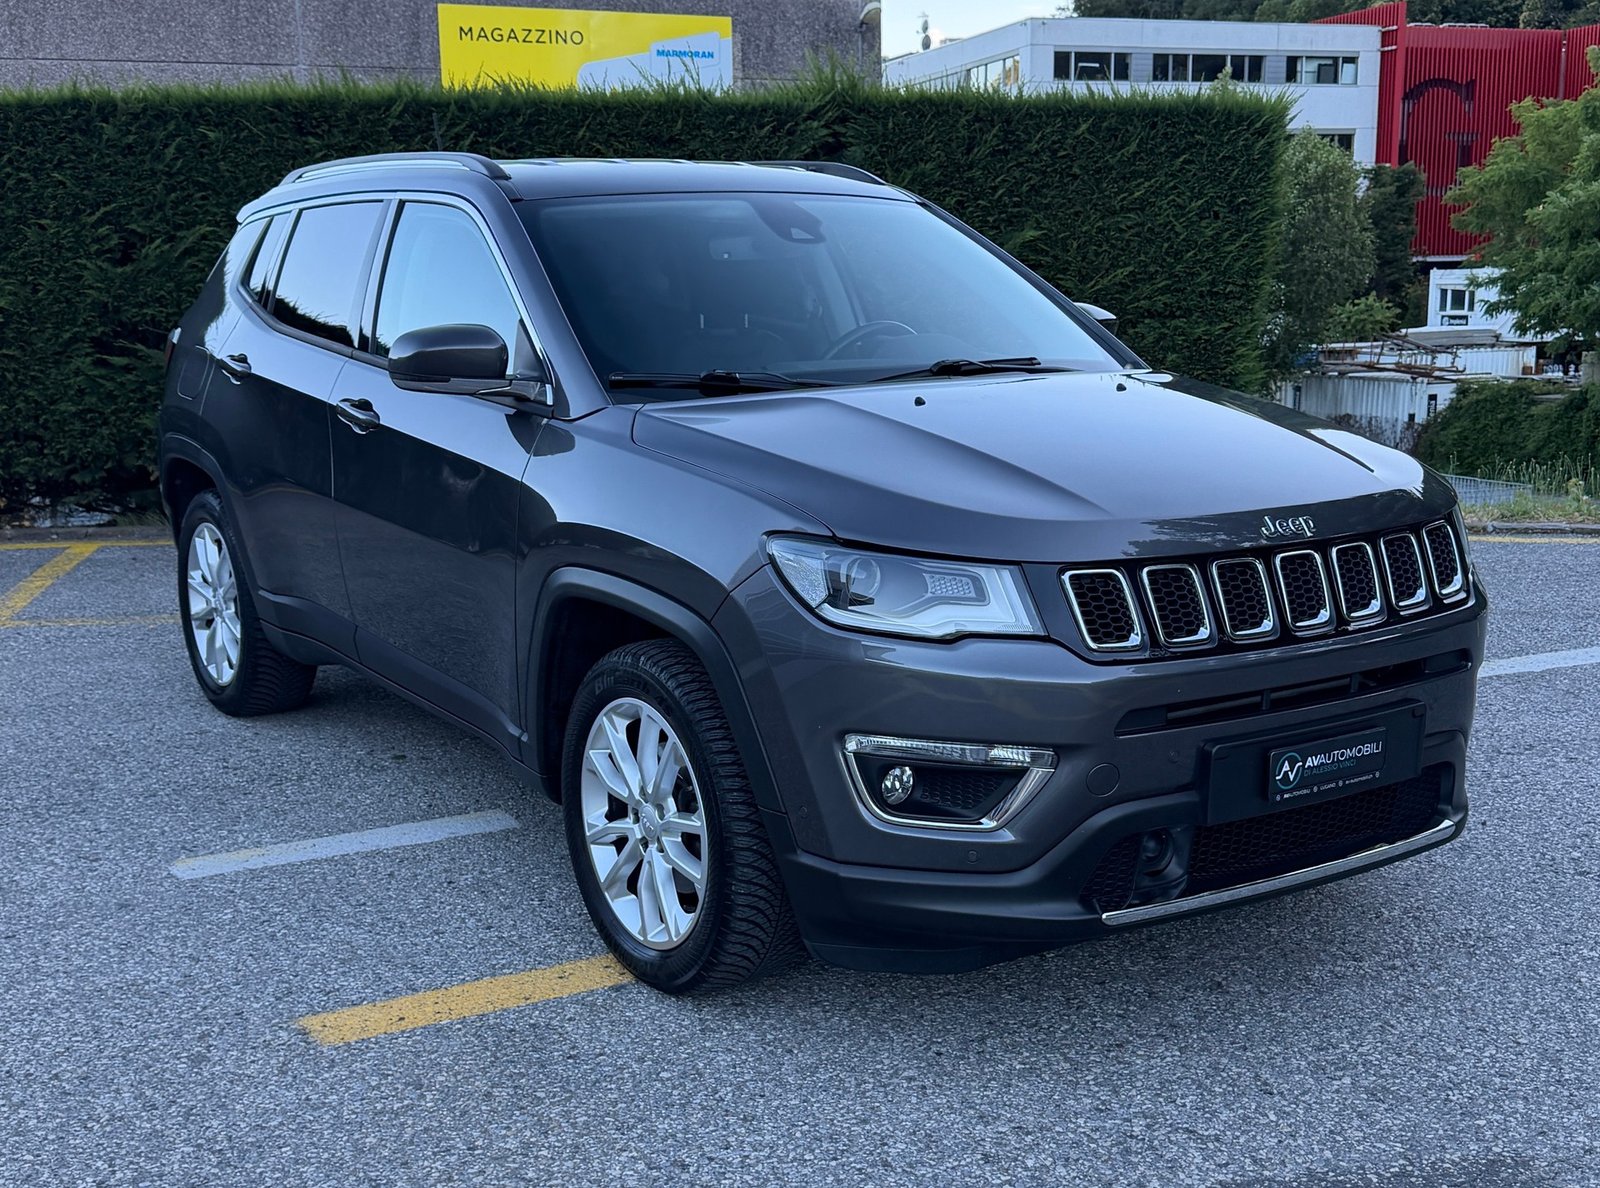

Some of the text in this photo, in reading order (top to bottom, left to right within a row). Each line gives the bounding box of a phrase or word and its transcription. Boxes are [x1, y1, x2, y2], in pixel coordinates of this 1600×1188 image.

[458, 26, 584, 46] MAGAZZINO
[656, 49, 714, 59] MARMORAN
[1260, 515, 1316, 539] Jeep
[1304, 741, 1382, 768] AVAUTOMOBILI
[1303, 759, 1357, 777] DI ALESSIO VINCI
